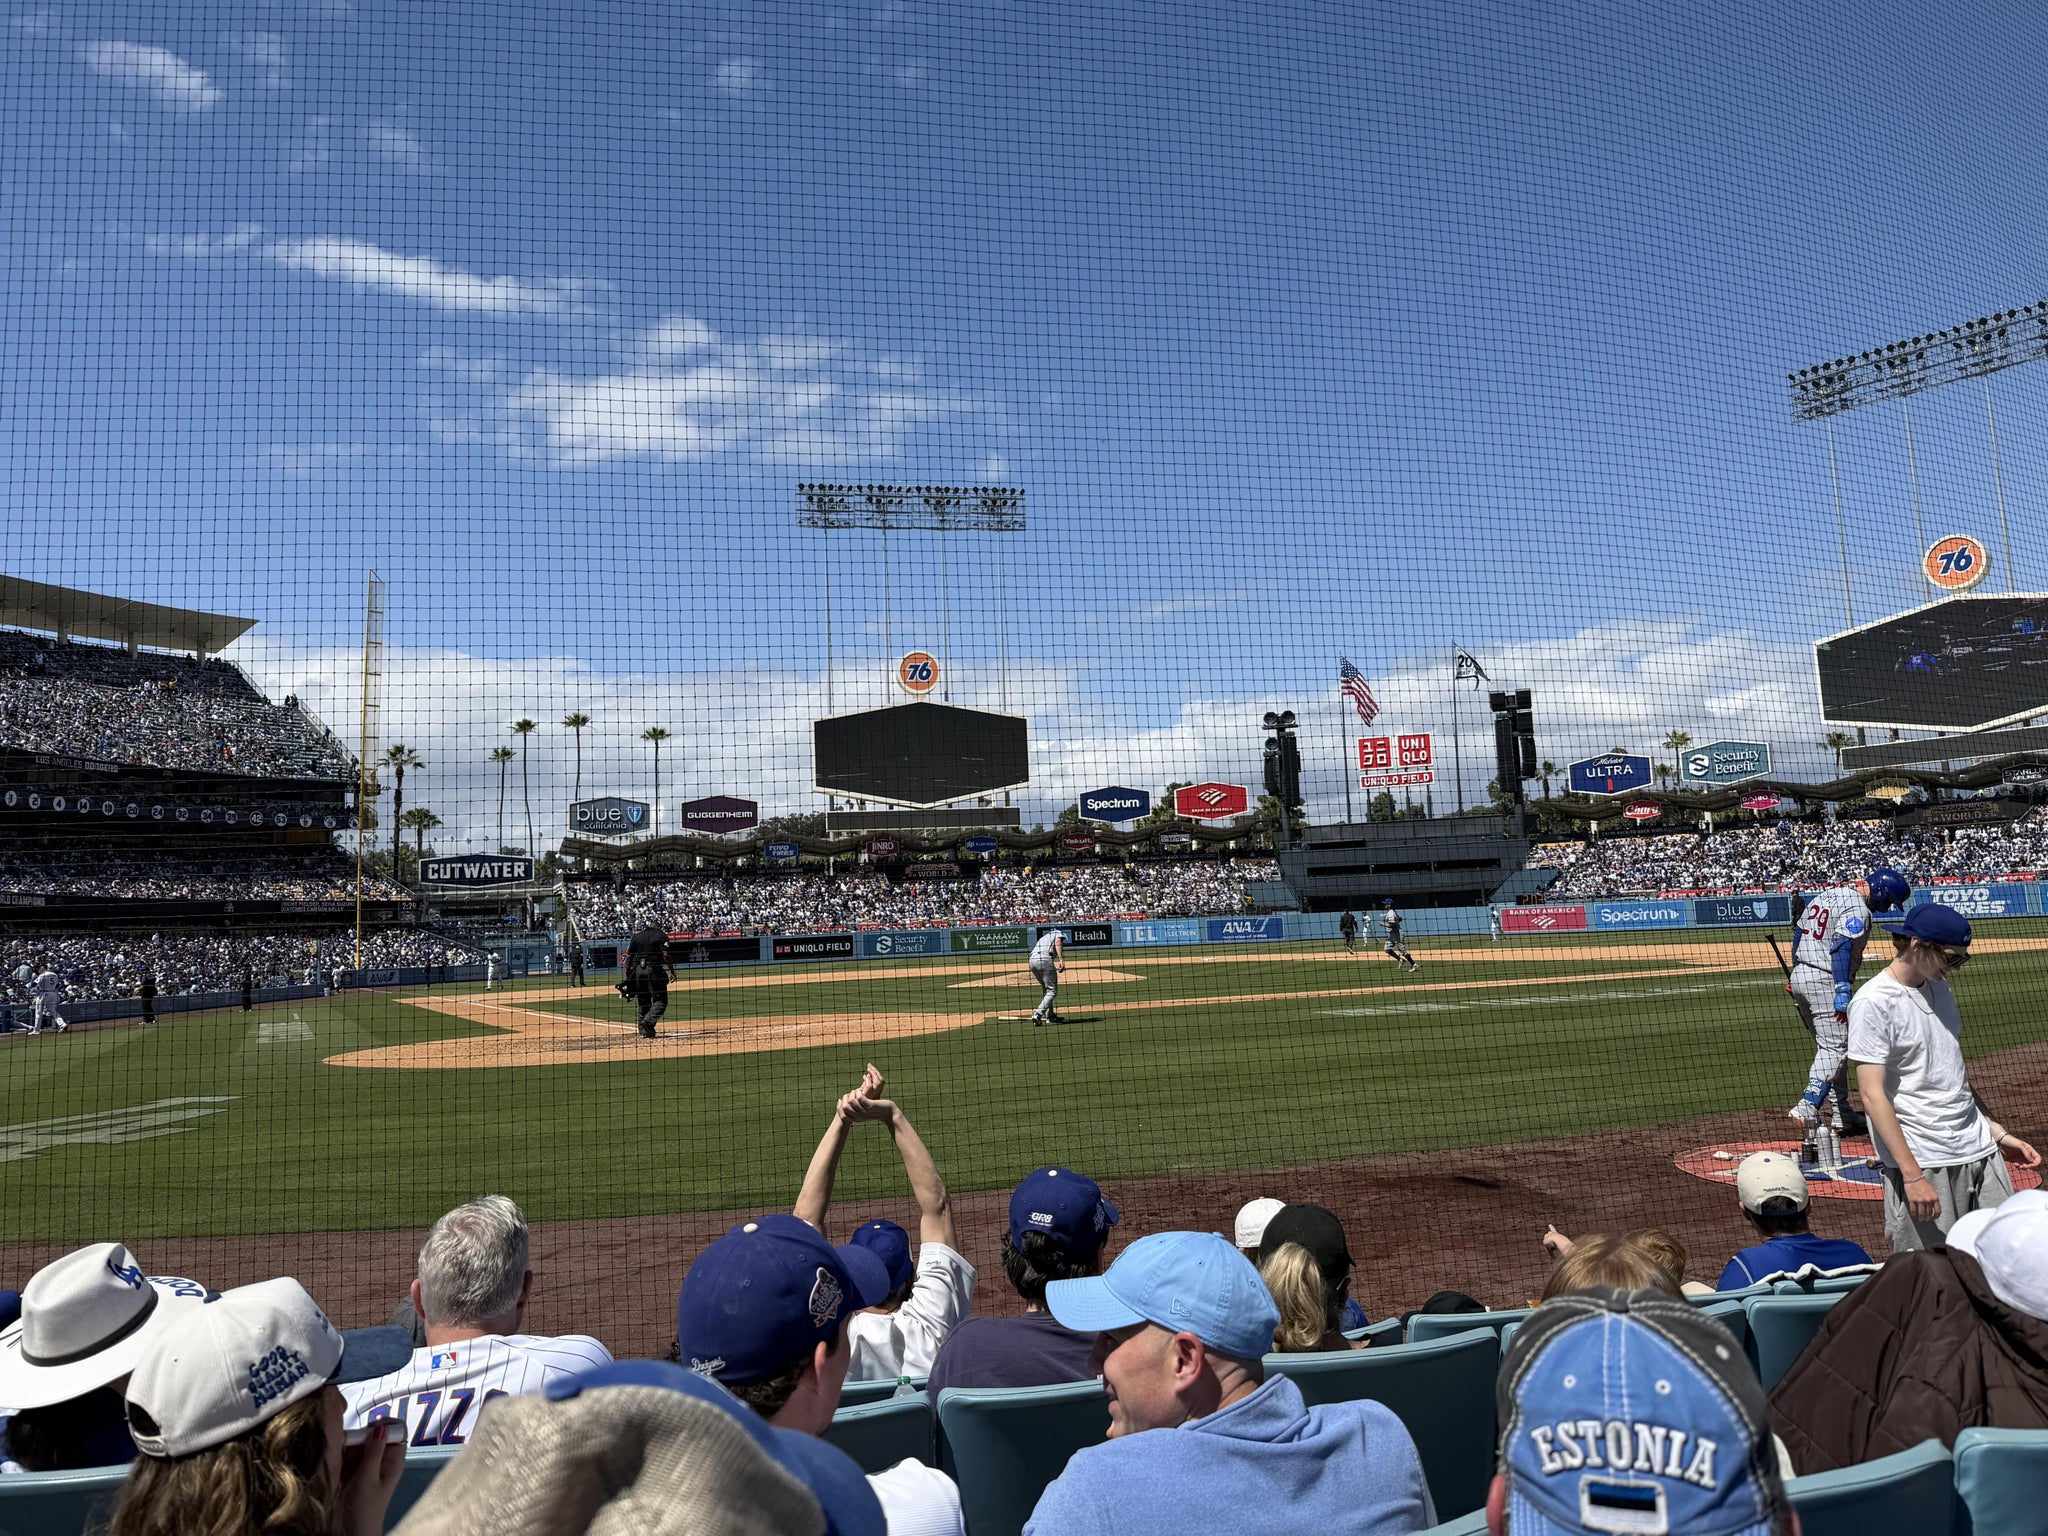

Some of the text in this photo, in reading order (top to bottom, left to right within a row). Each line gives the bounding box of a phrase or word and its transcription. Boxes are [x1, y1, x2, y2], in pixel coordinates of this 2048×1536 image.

[1939, 546, 1974, 575] 76
[907, 661, 932, 681] 76
[1401, 738, 1425, 750] UNI
[1402, 750, 1427, 763] QLO
[1713, 749, 1760, 762] Security
[1586, 764, 1633, 778] ULTRA
[1715, 760, 1757, 775] Benefit
[1364, 773, 1430, 787] UNIQLO FIELD
[1087, 799, 1140, 811] Spectrum
[576, 805, 621, 821] blue
[584, 822, 626, 830] california
[872, 842, 893, 851] JINRO
[428, 862, 525, 879] CUTWATER
[1931, 888, 1990, 903] TOYO
[1717, 903, 1752, 917] blue
[1937, 900, 2006, 914] IRES
[1601, 908, 1673, 925] Spectrum
[1803, 904, 1830, 940] 29
[1122, 926, 1158, 942] TEL
[1164, 929, 1197, 937] ELECTRON
[1222, 921, 1252, 933] ANA
[895, 935, 928, 946] Security
[1075, 930, 1107, 941] Health
[793, 944, 824, 953] UNIQLO
[826, 942, 851, 951] FIELD
[895, 944, 923, 953] Benefit
[1031, 1212, 1053, 1223] GR8
[249, 1345, 287, 1378] GOOD
[692, 1356, 725, 1375] Dodgers
[253, 1361, 310, 1408] HUMAN
[1531, 1420, 1717, 1490] ESTONIA
